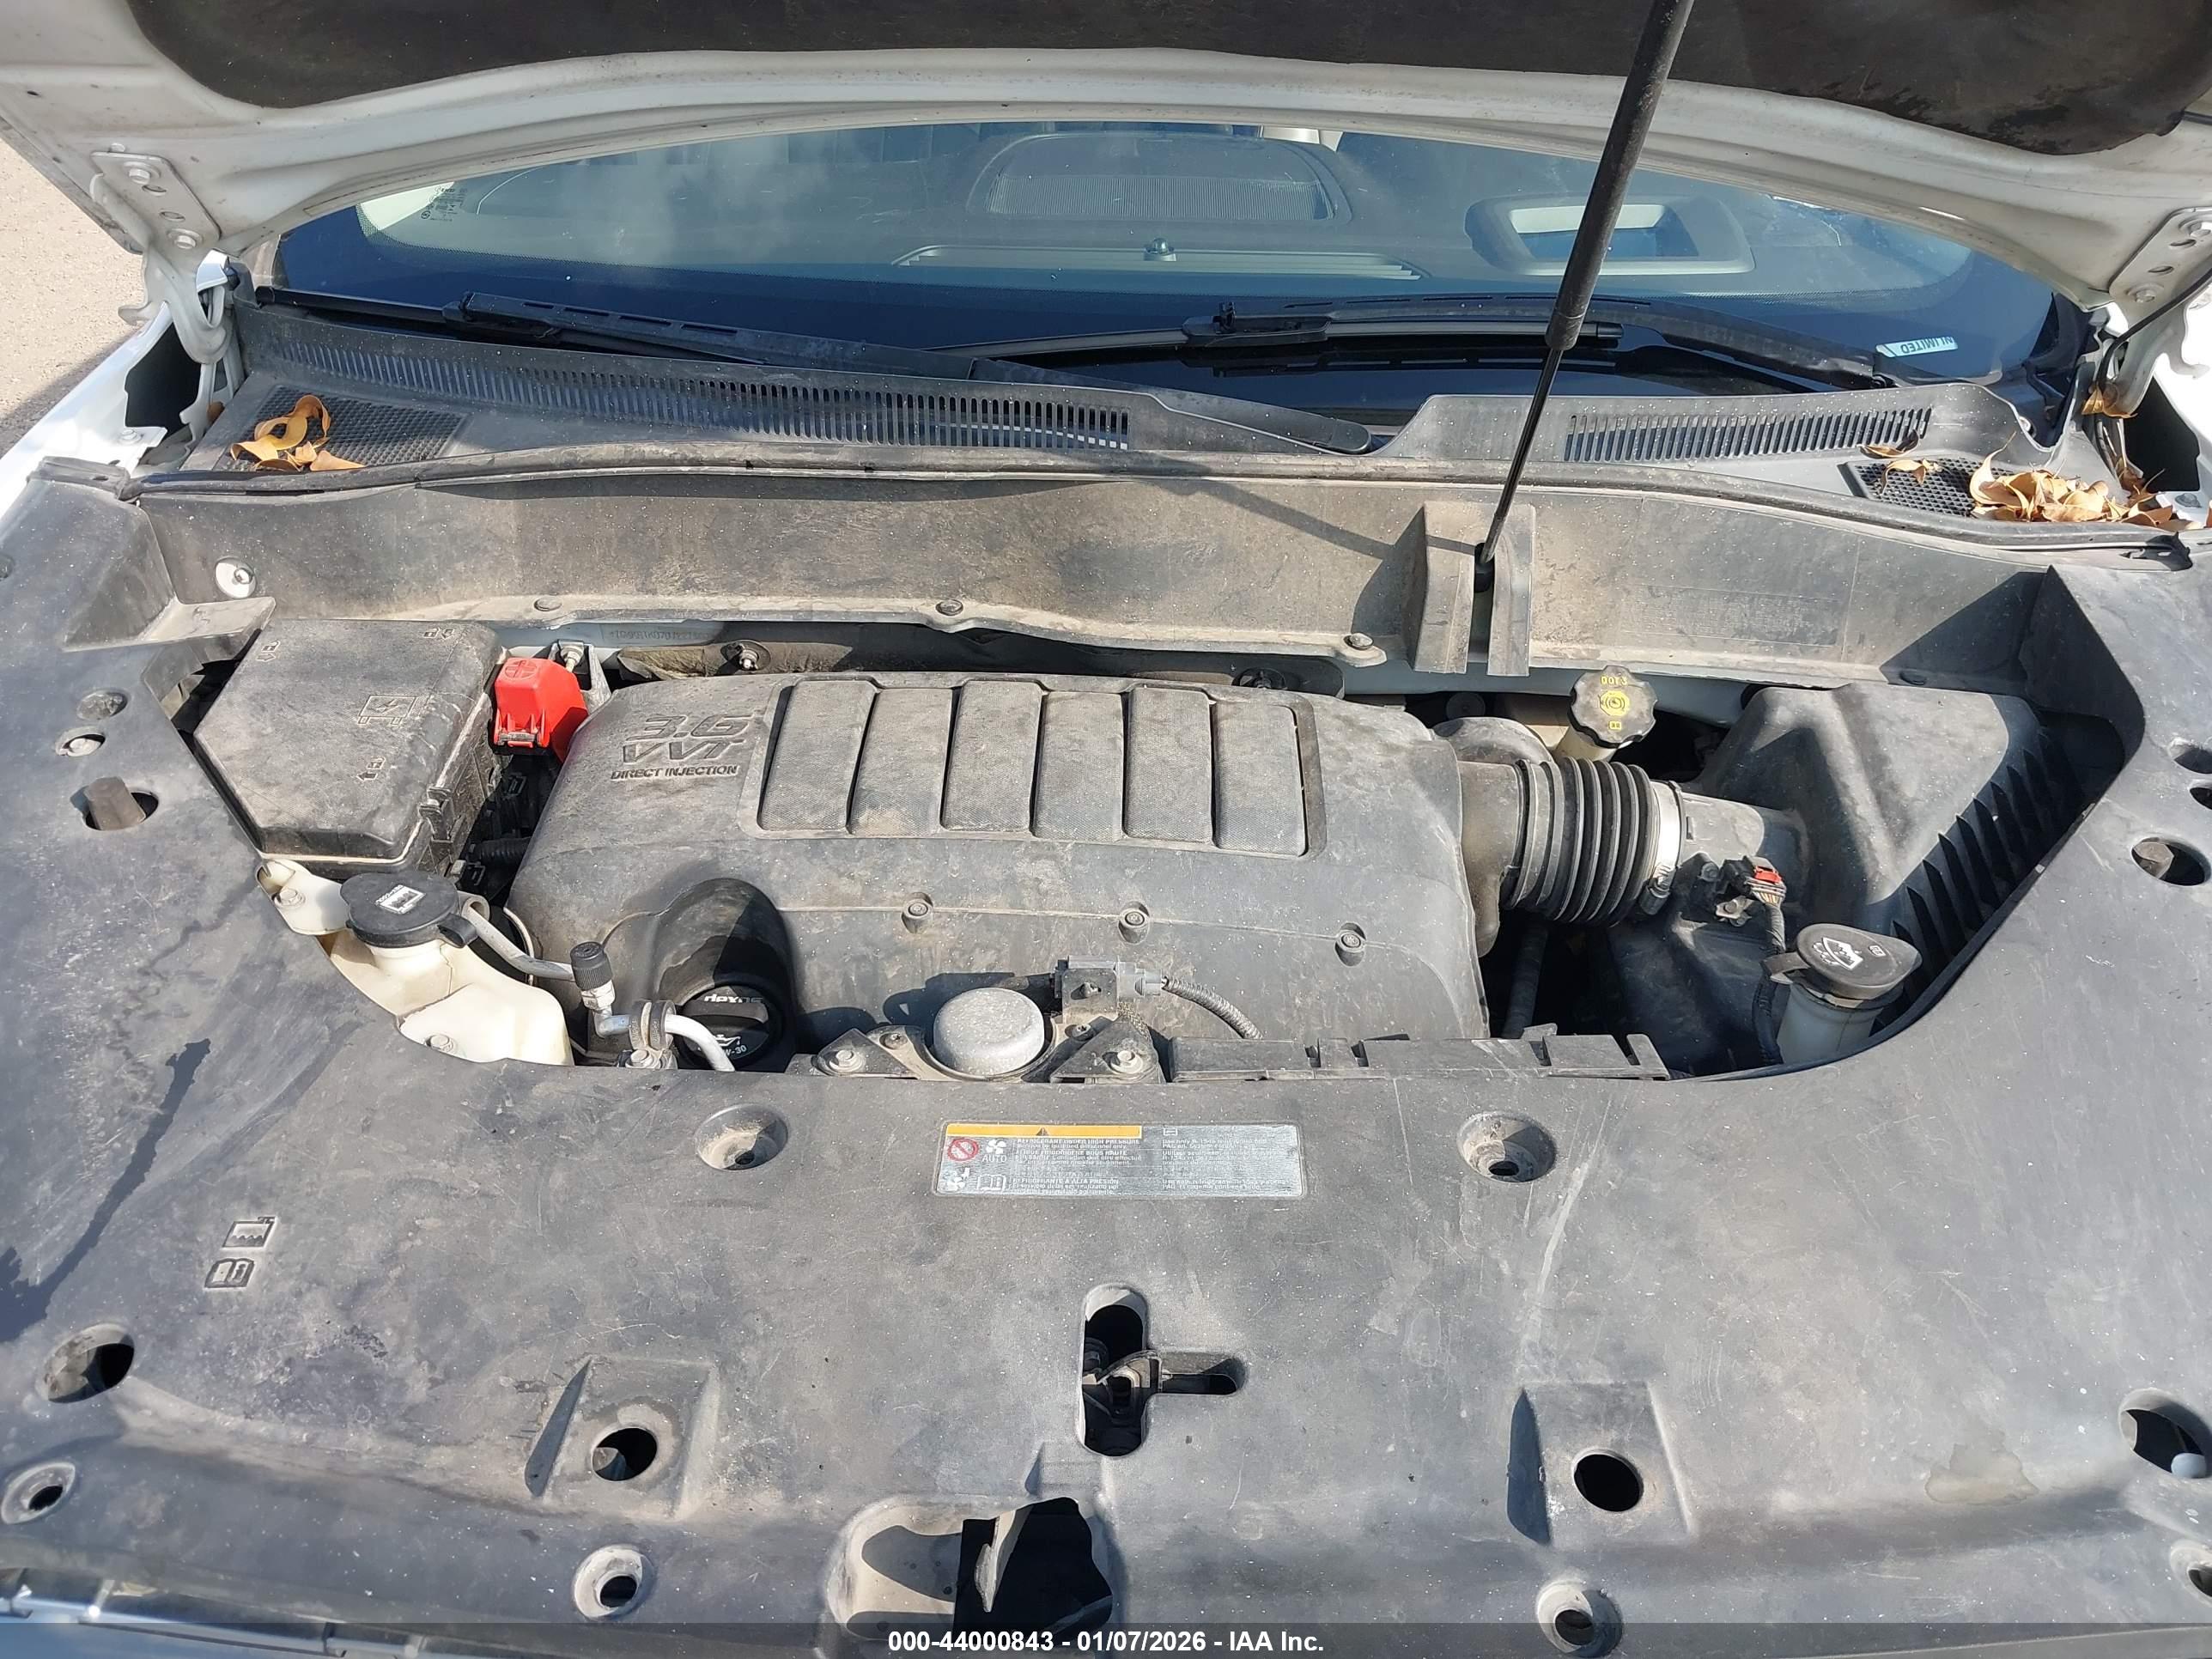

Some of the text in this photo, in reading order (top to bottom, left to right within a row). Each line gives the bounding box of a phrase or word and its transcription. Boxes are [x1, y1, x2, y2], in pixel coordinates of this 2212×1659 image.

[625, 714, 755, 741] 3.6
[623, 738, 746, 763] VVT
[611, 765, 740, 781] DIRECT INJECTION
[723, 1044, 747, 1057] W-30
[981, 1154, 1007, 1163] AUTO
